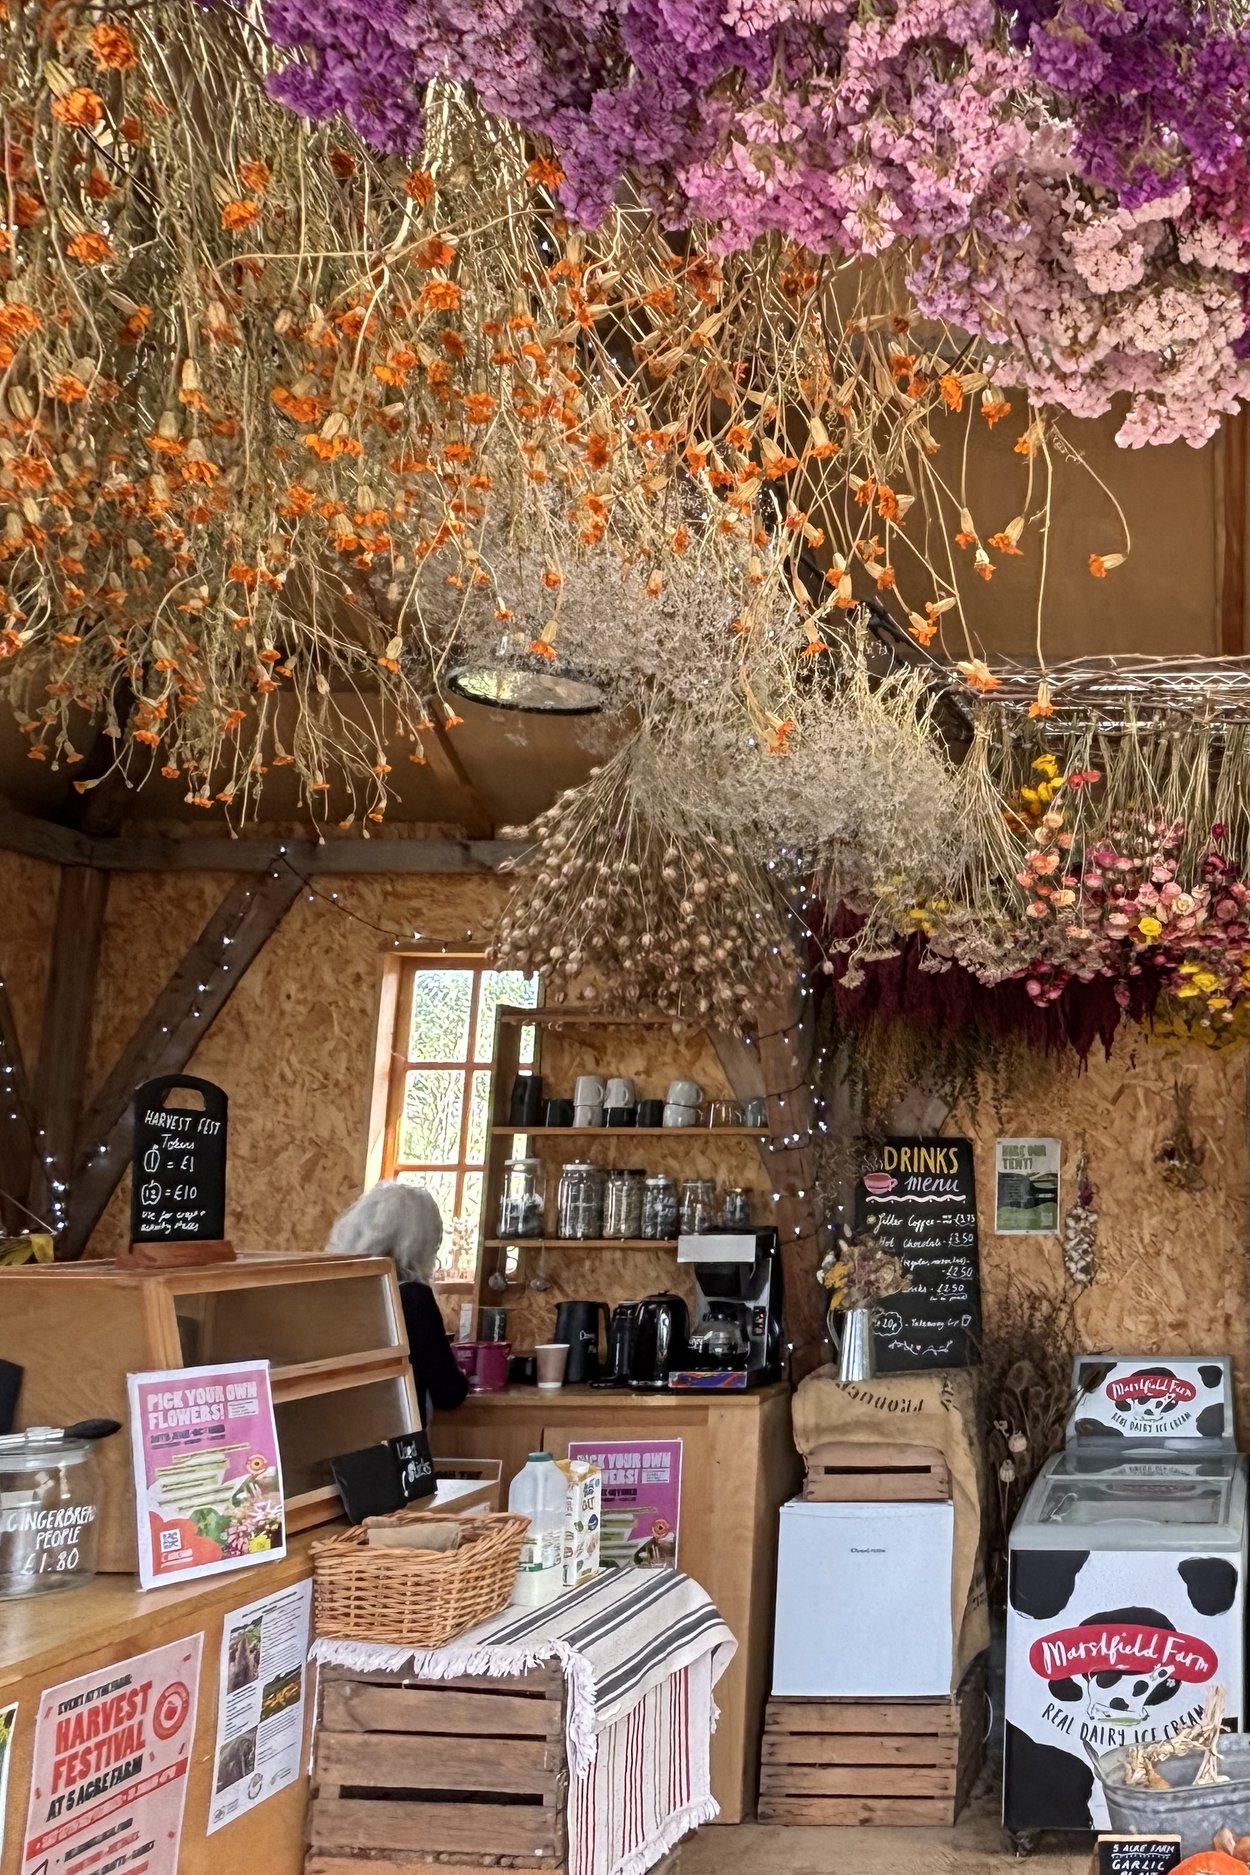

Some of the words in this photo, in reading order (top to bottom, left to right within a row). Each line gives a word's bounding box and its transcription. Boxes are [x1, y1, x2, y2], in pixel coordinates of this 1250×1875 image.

[144, 1110, 192, 1131] HARVEST
[197, 1118, 222, 1135] FEST
[181, 1155, 194, 1172] £1
[884, 1147, 958, 1174] DRINKS
[174, 1184, 198, 1200] £10
[904, 1176, 960, 1192] menu
[880, 1235, 894, 1248] Hot
[147, 1390, 184, 1412] PICK
[184, 1386, 225, 1406] YOUR
[226, 1381, 257, 1401] OWN
[148, 1402, 224, 1430] FLOWERS!
[608, 1452, 640, 1468] YOUR
[643, 1452, 671, 1468] OWN
[36, 1526, 82, 1550] PEOPLE
[22, 1548, 80, 1574] £1.80
[1042, 1632, 1158, 1674] Marshfield
[1162, 1636, 1208, 1672] Farm
[55, 1680, 152, 1755] HARVEST
[1042, 1702, 1075, 1736] REAL
[1080, 1722, 1124, 1746] DAIRY
[1134, 1728, 1156, 1745] ICE
[1164, 1704, 1205, 1740] CREAM
[51, 1720, 146, 1795] FESTIVAL
[46, 1795, 66, 1822] AT
[66, 1789, 78, 1812] 5
[76, 1770, 111, 1806] ACRE
[110, 1754, 144, 1788] FARM
[1113, 1844, 1120, 1852] 5
[1122, 1844, 1148, 1852] ACRE
[1150, 1844, 1175, 1853] FARM
[1112, 1859, 1164, 1870] GARLIC
